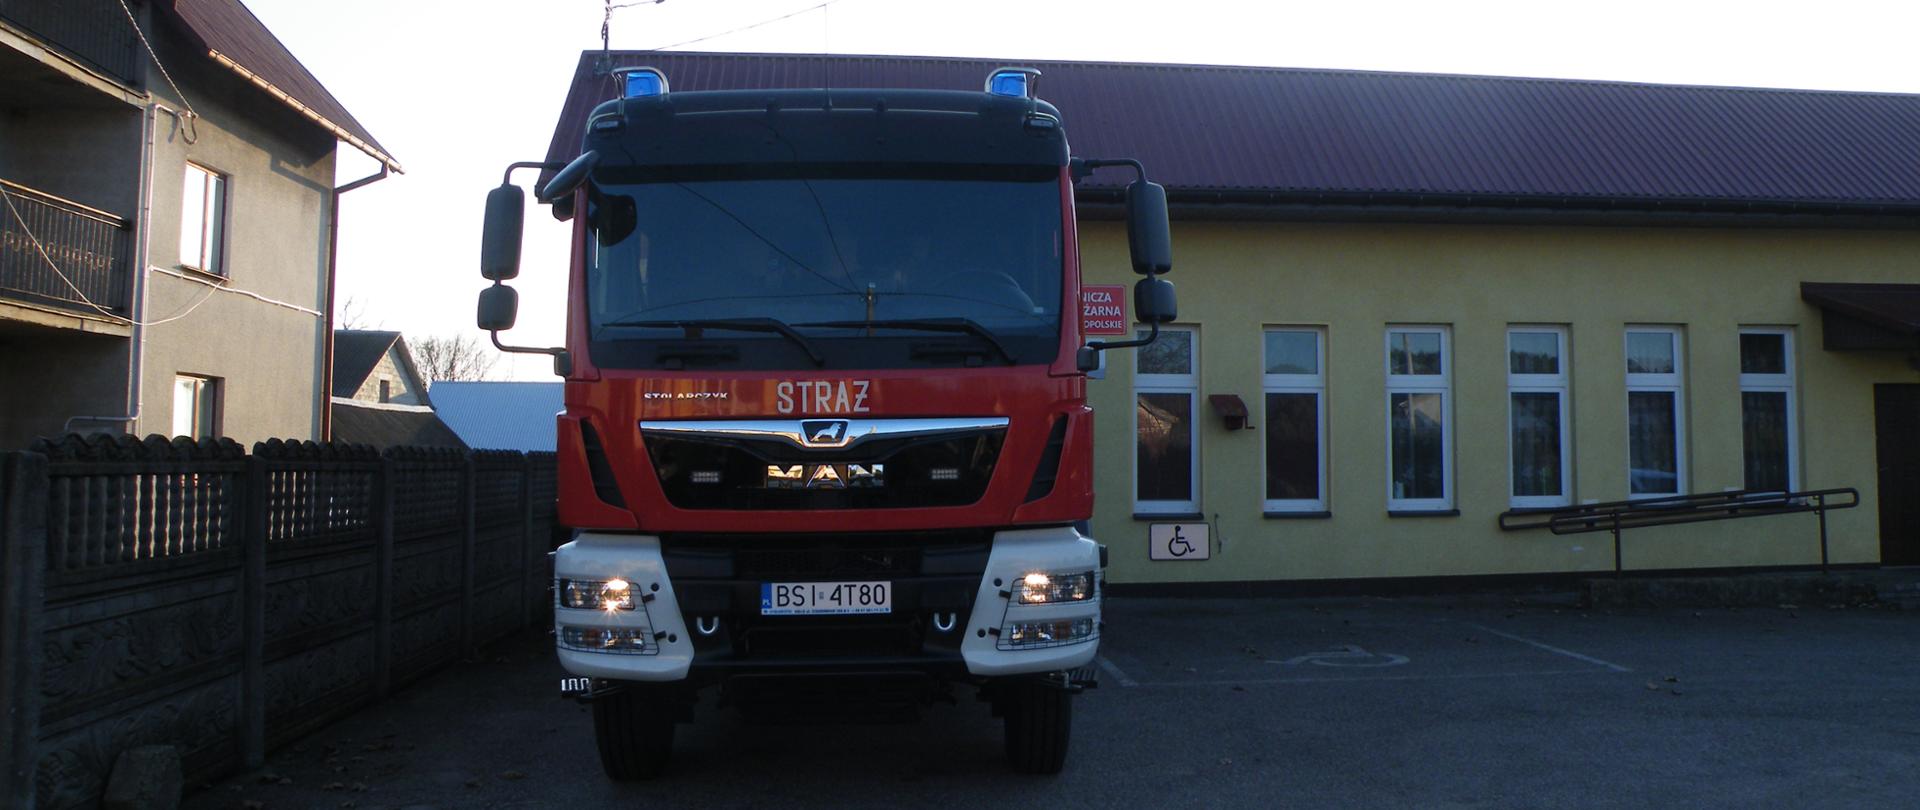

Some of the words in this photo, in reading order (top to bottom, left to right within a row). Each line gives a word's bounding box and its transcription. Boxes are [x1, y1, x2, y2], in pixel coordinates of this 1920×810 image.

[1083, 303, 1121, 317] ŻARNA
[776, 380, 870, 413] STRAŻ
[767, 464, 885, 488] MAN
[777, 585, 816, 607] BSI
[830, 584, 885, 607] 4T80
